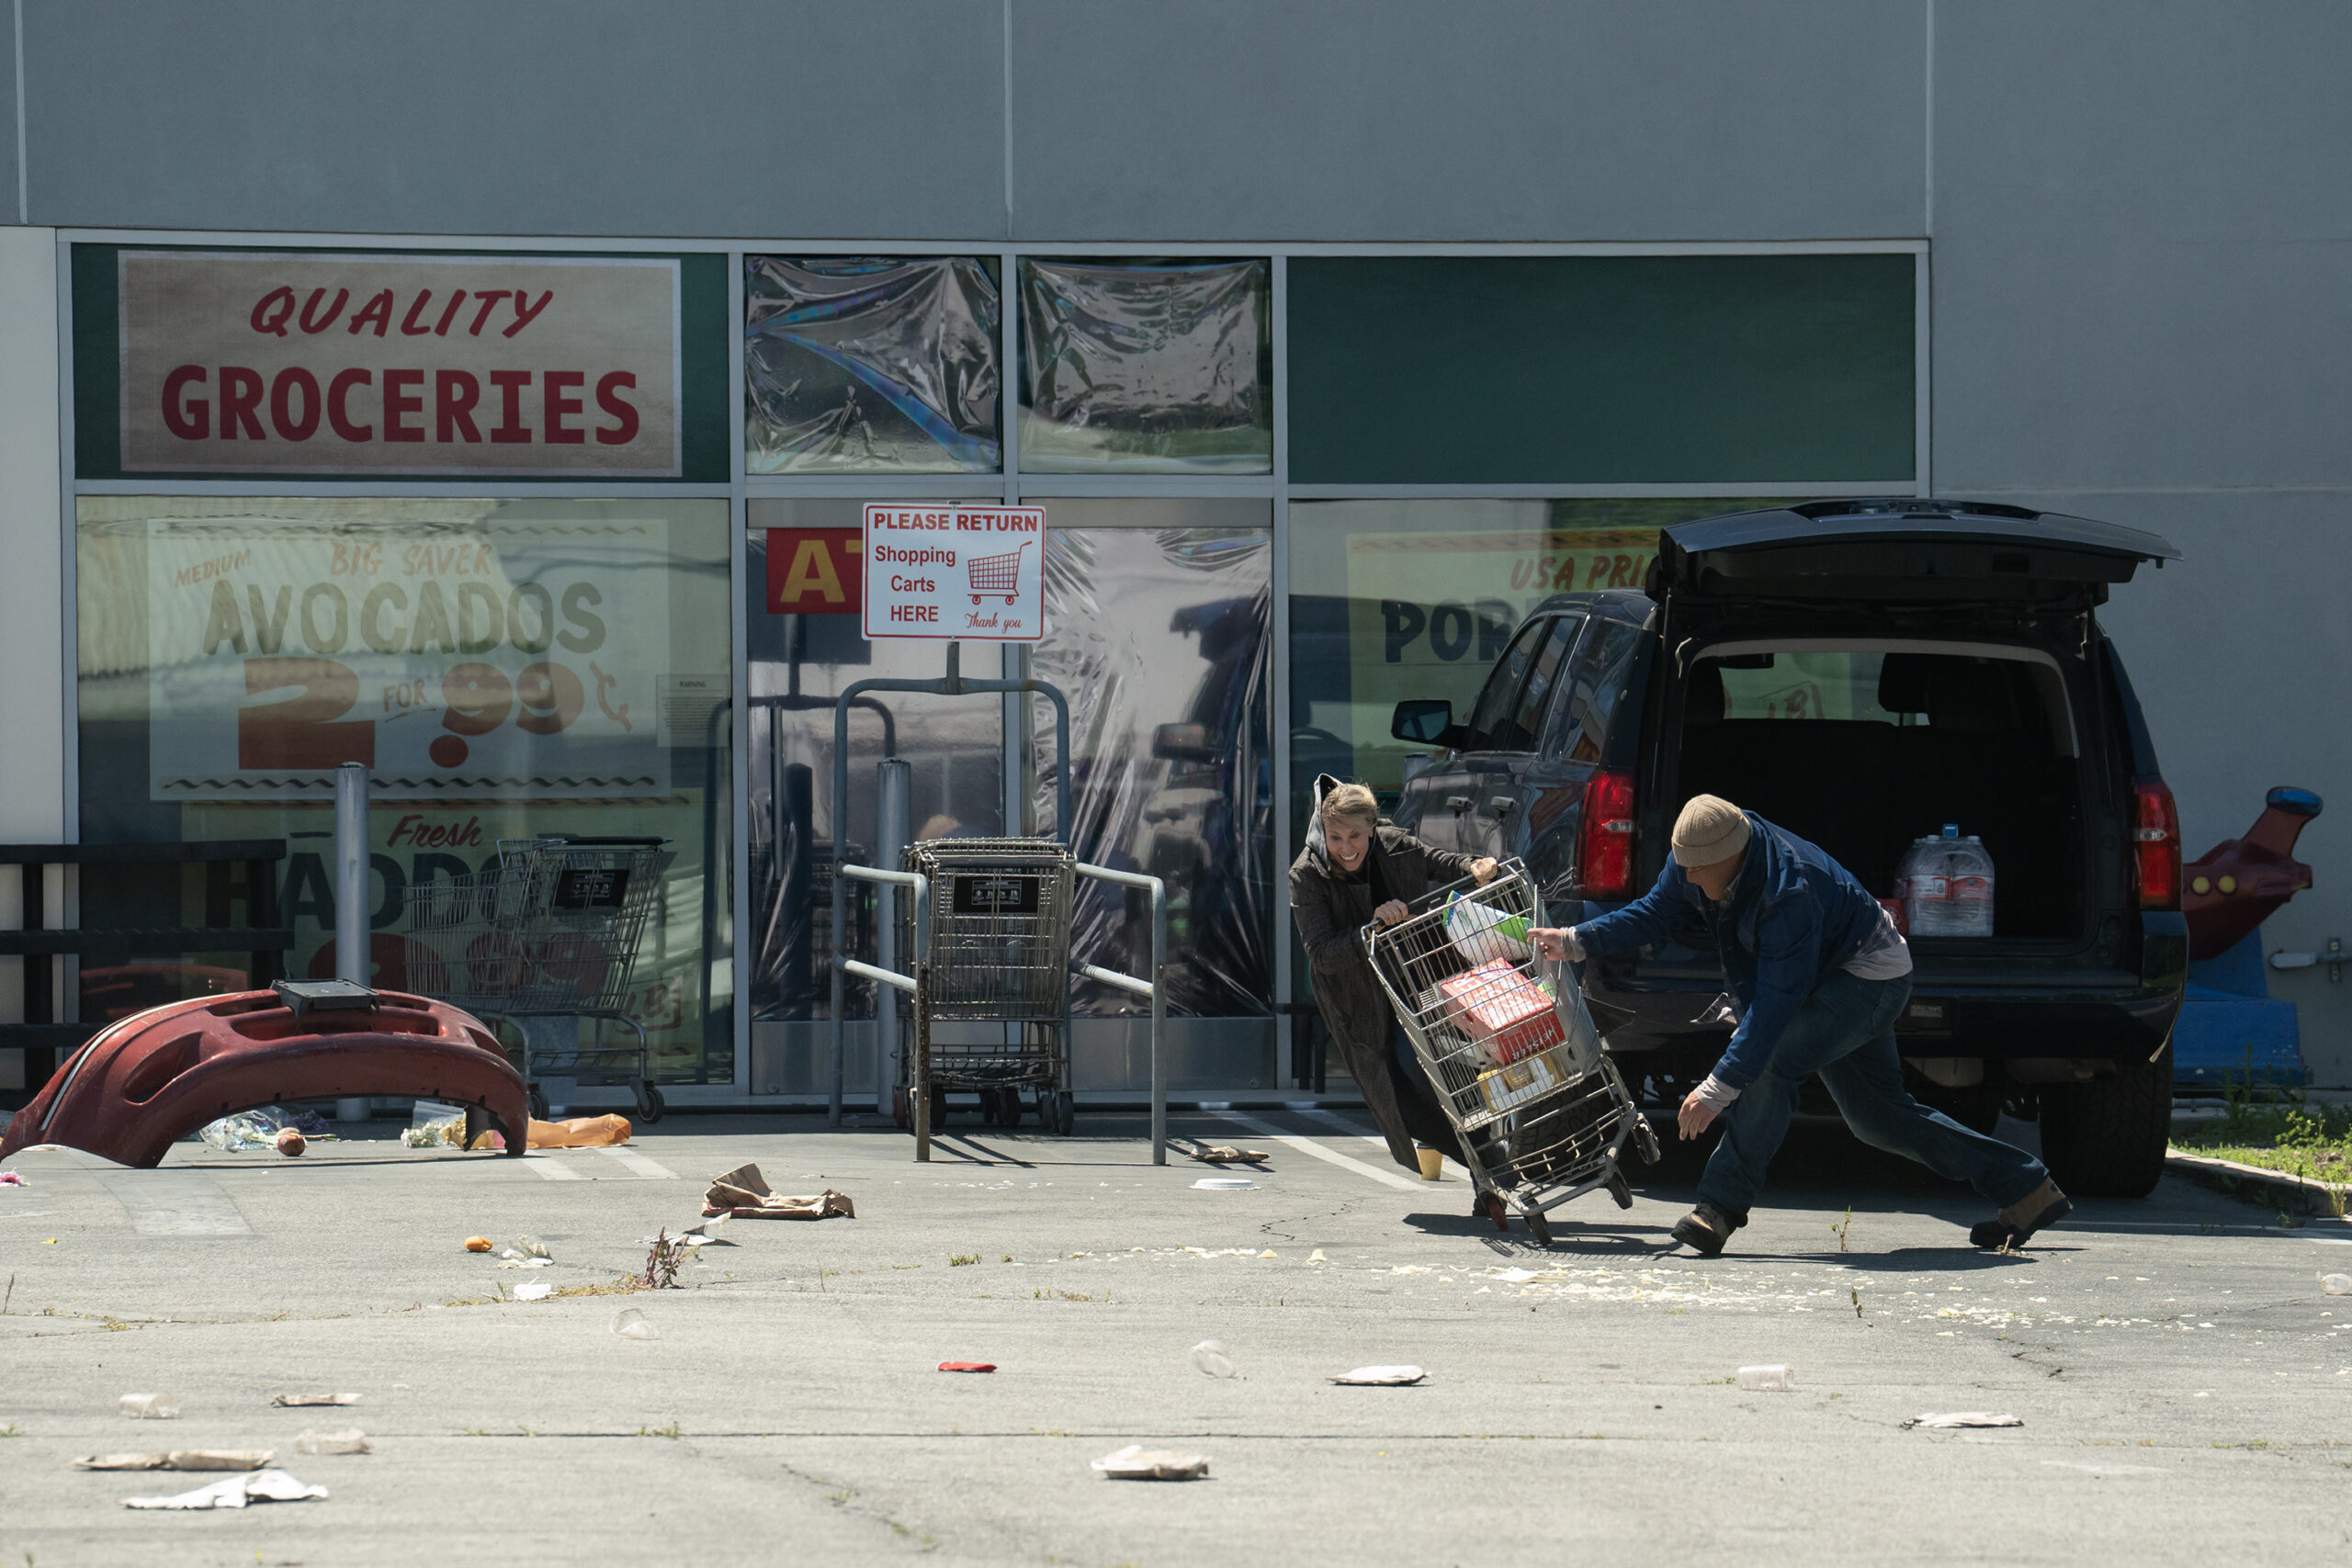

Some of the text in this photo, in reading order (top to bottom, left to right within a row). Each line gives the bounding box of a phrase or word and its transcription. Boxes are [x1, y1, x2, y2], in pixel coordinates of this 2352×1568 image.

[250, 286, 554, 338] QUALITY
[162, 365, 639, 446] GROCERIES
[874, 513, 1038, 532] PLEASE RETURN
[174, 548, 253, 588] MEDIUM
[330, 542, 493, 576] BIG SAVER
[780, 539, 863, 603] A
[875, 546, 956, 568] Shopping
[1510, 555, 1652, 592] USA PRI
[890, 575, 935, 592] Carts
[202, 579, 606, 655] AVOCADOS
[890, 605, 939, 622] HERE
[964, 611, 1023, 634] Thank you
[1381, 597, 1540, 663] POR
[238, 657, 376, 770] 2
[382, 678, 430, 712] FOR
[387, 814, 484, 849] Fresh
